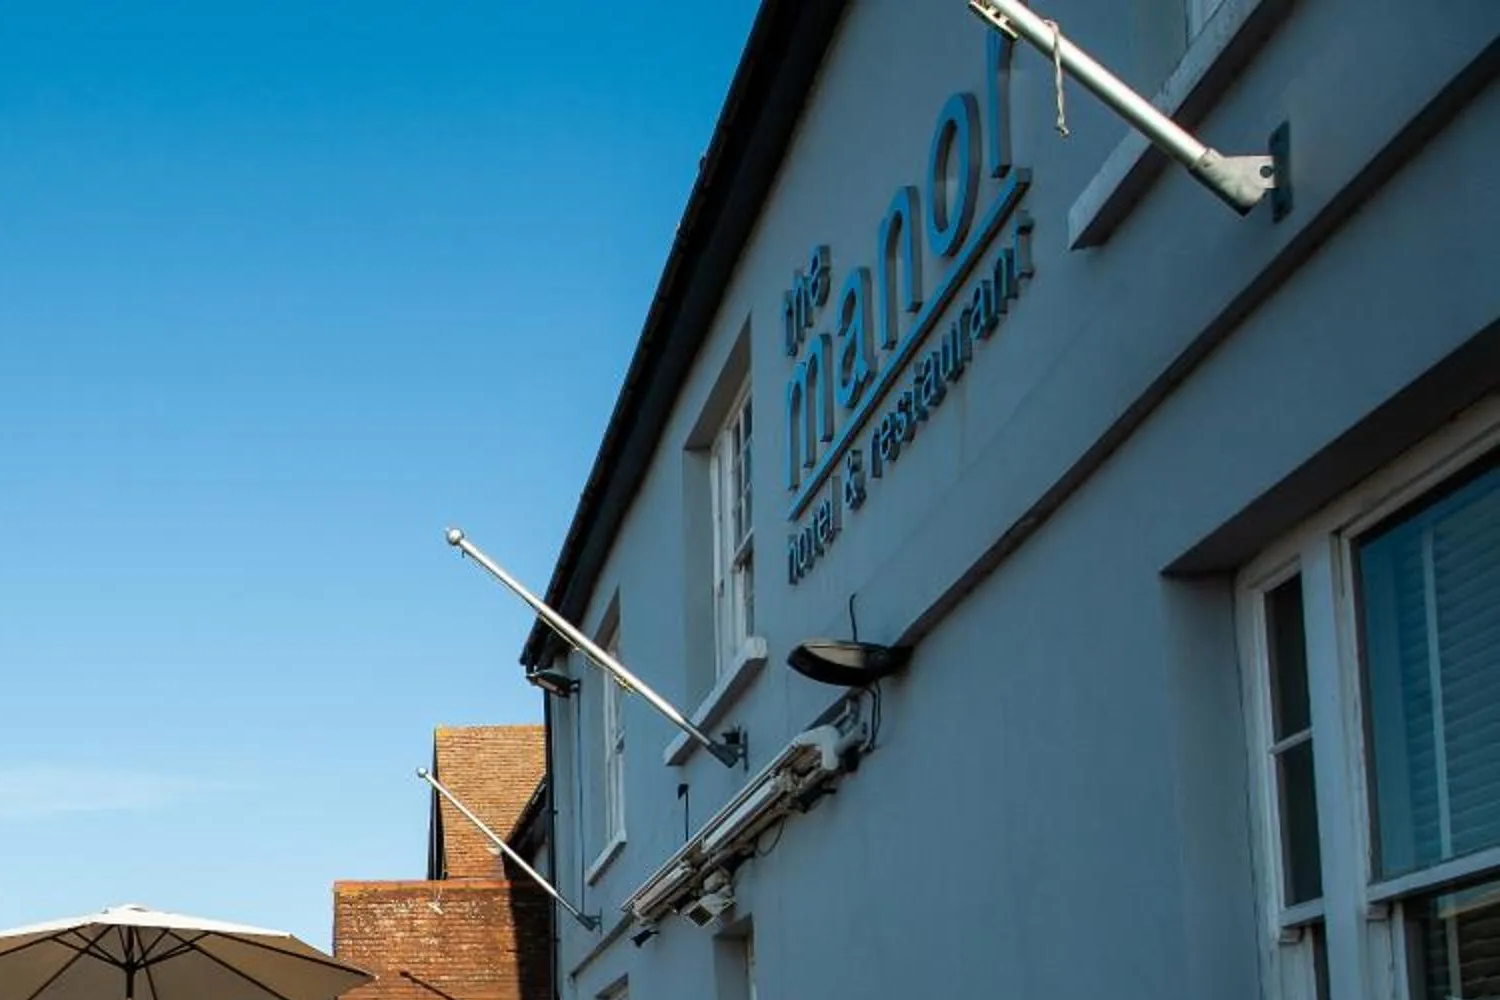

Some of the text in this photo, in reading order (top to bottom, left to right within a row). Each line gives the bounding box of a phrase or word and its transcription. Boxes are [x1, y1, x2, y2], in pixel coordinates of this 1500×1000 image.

[783, 244, 832, 356] the
[786, 210, 1036, 586] hotel & restaurant
